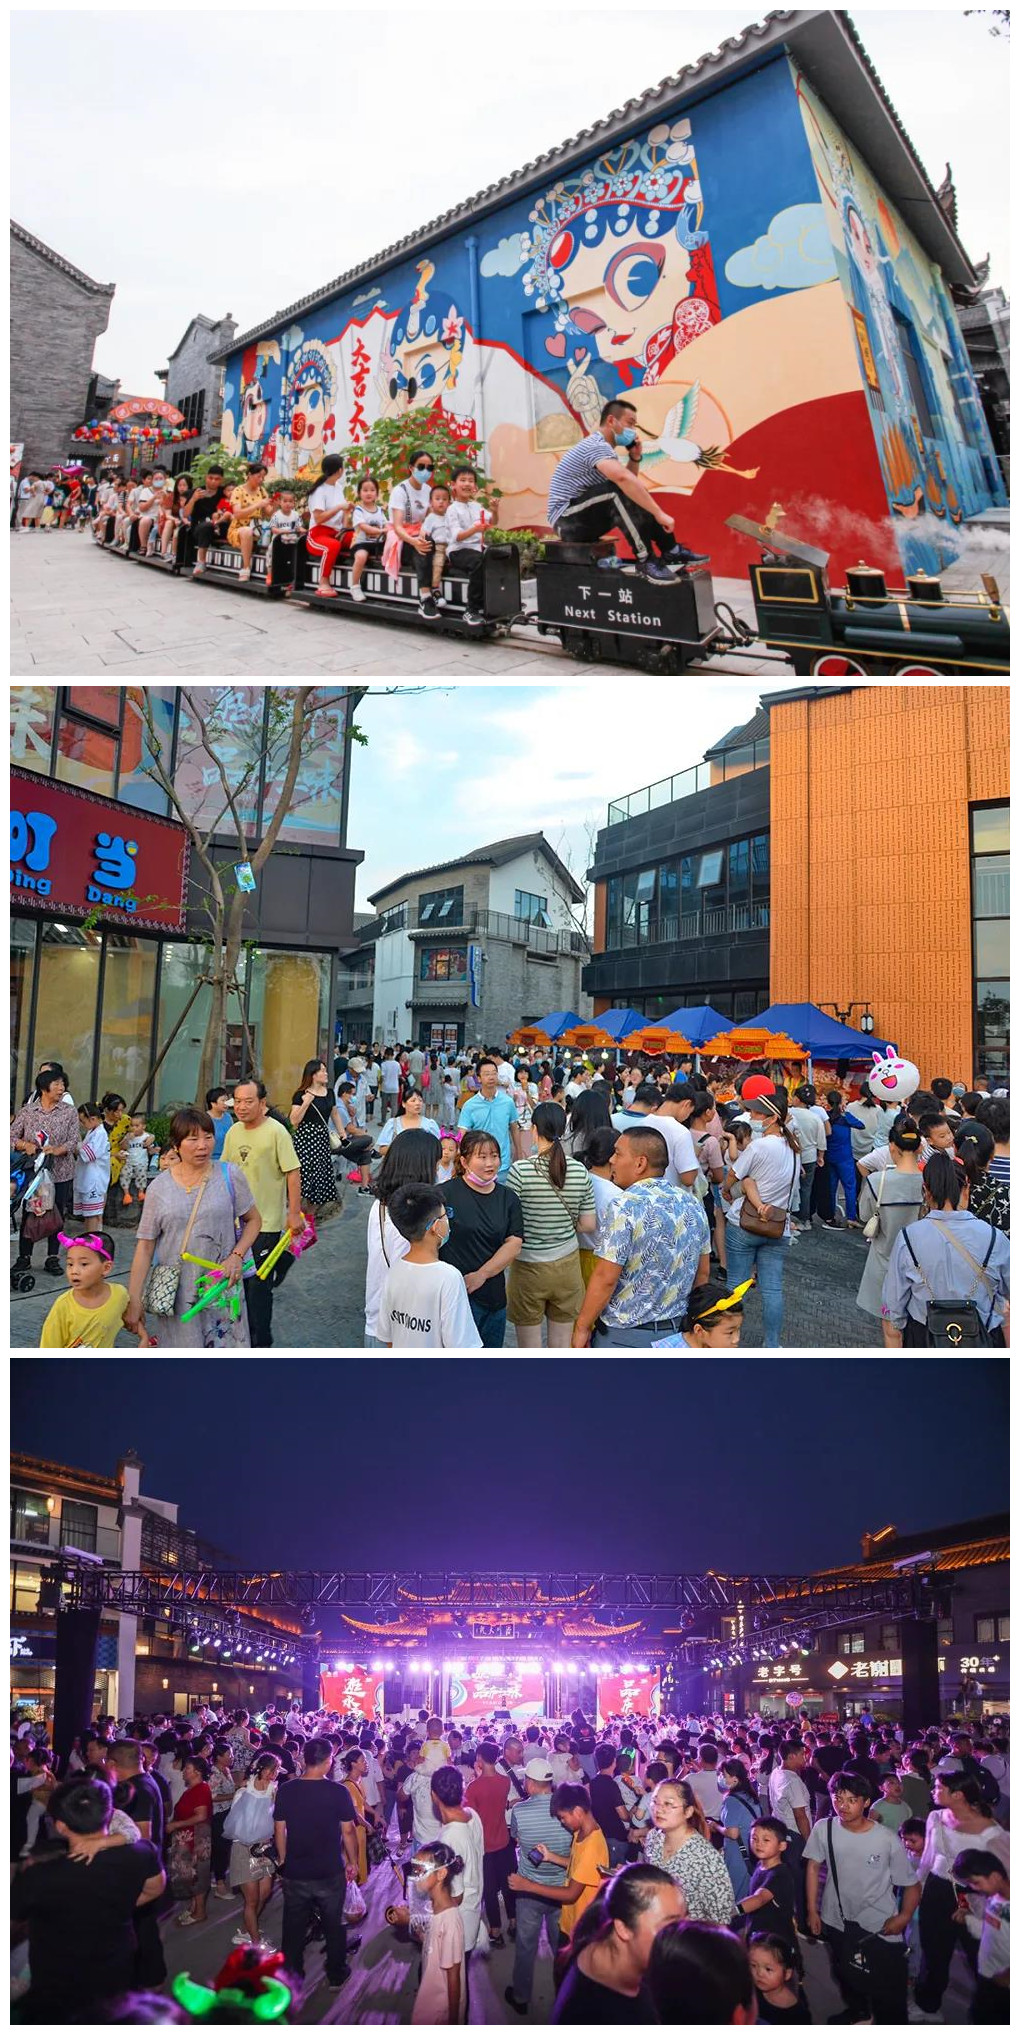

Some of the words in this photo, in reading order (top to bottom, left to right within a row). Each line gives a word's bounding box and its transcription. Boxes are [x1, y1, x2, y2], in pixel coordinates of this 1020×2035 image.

[348, 337, 372, 443] 大吉大
[578, 586, 633, 604] 下一站
[564, 605, 596, 619] Next
[607, 609, 662, 627] Station
[86, 885, 138, 914] Dang
[757, 1664, 802, 1678] 老字号
